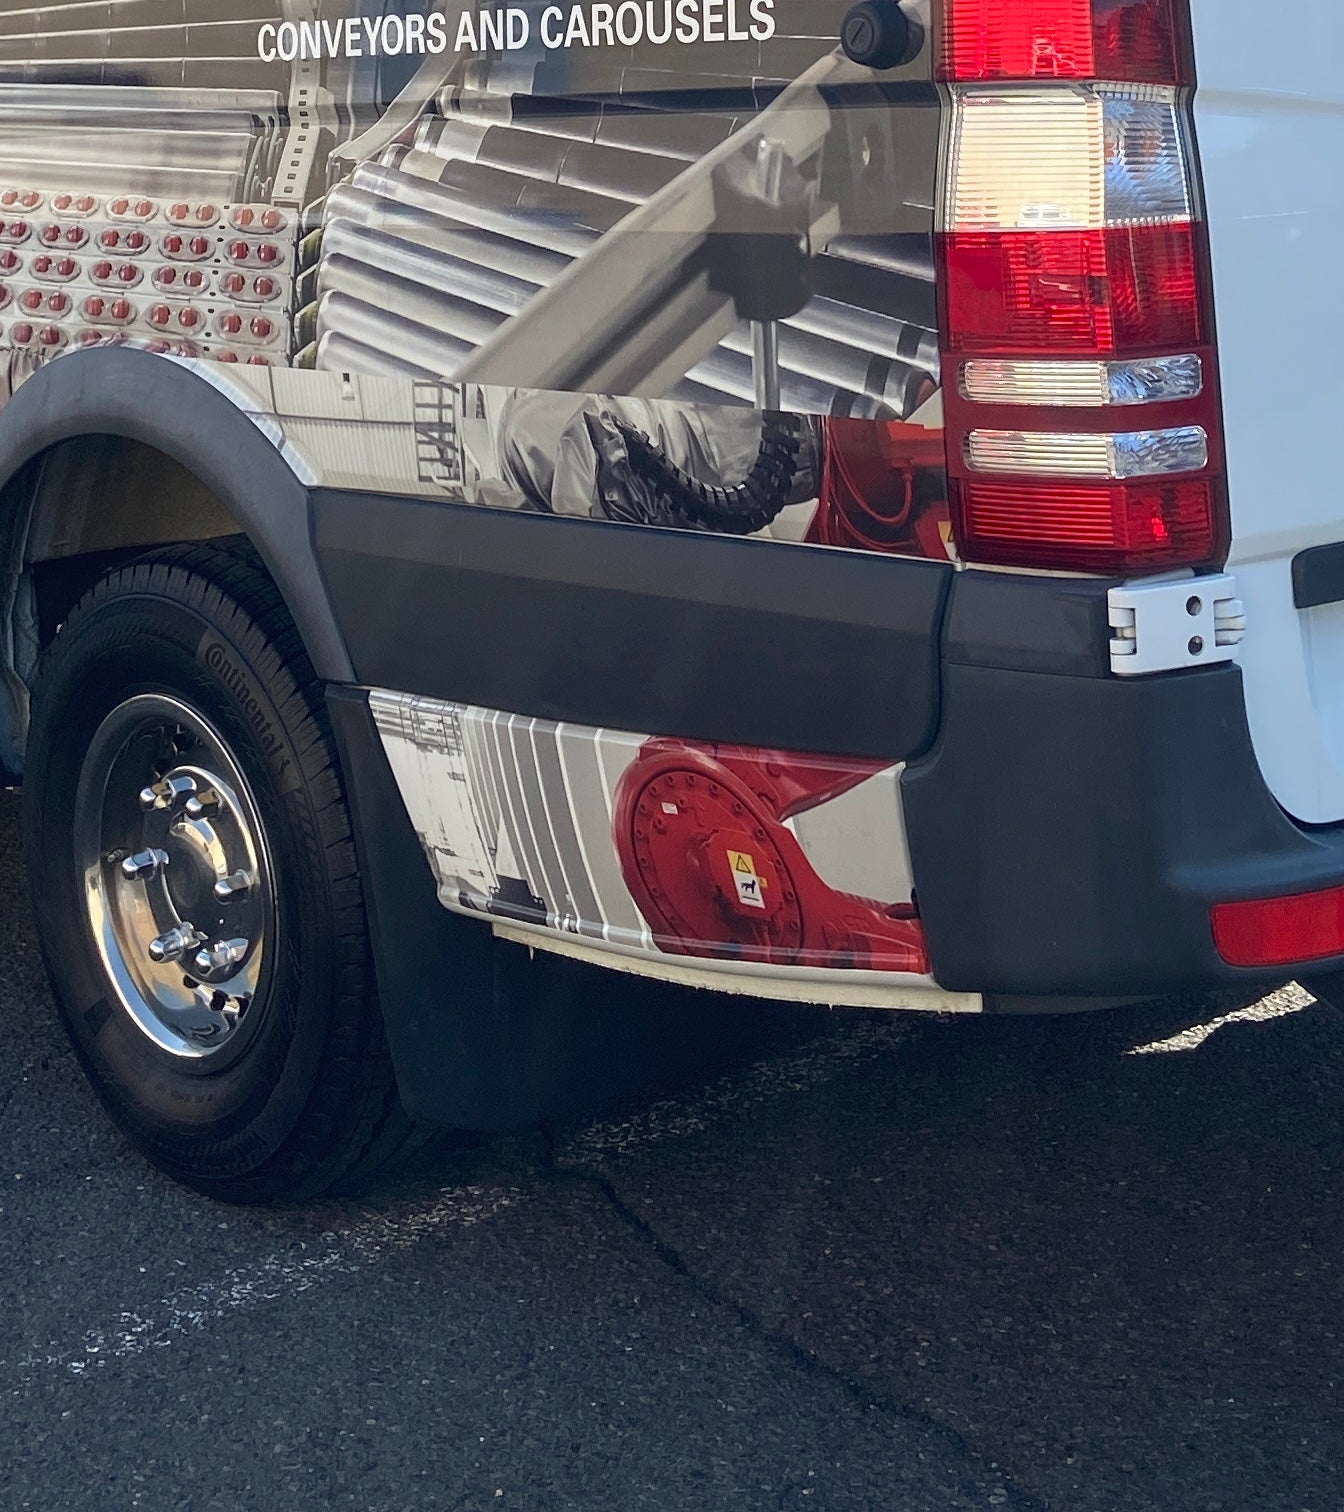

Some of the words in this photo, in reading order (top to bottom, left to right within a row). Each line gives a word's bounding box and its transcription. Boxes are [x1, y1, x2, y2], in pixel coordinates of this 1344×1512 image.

[257, 12, 447, 62] CONVEYORS
[453, 7, 529, 52] AND
[206, 642, 284, 757] Continental
